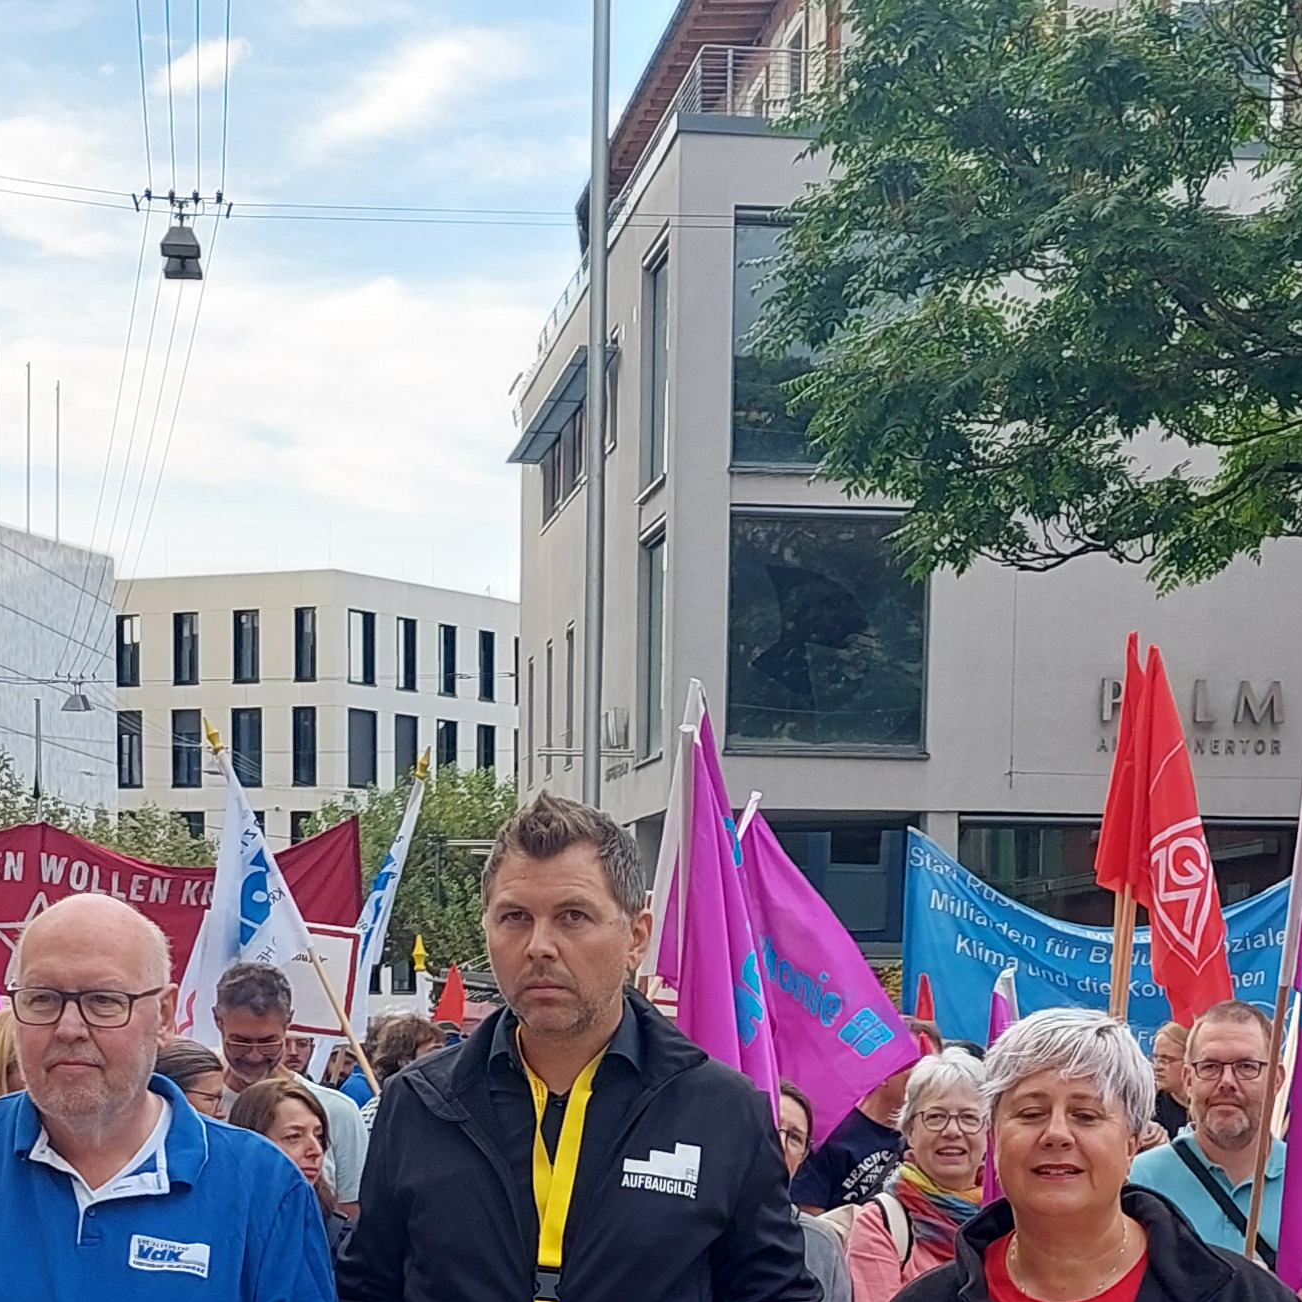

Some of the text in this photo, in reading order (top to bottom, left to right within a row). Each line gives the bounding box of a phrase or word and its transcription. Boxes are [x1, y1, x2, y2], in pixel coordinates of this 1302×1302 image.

[1100, 678, 1286, 724] PLM
[39, 850, 172, 904] WOLLEN
[955, 933, 1019, 972] Klima
[1027, 962, 1069, 988] und
[1077, 976, 1112, 996] die
[1045, 937, 1082, 961] für
[621, 1173, 698, 1199] AUFBAUGILDE
